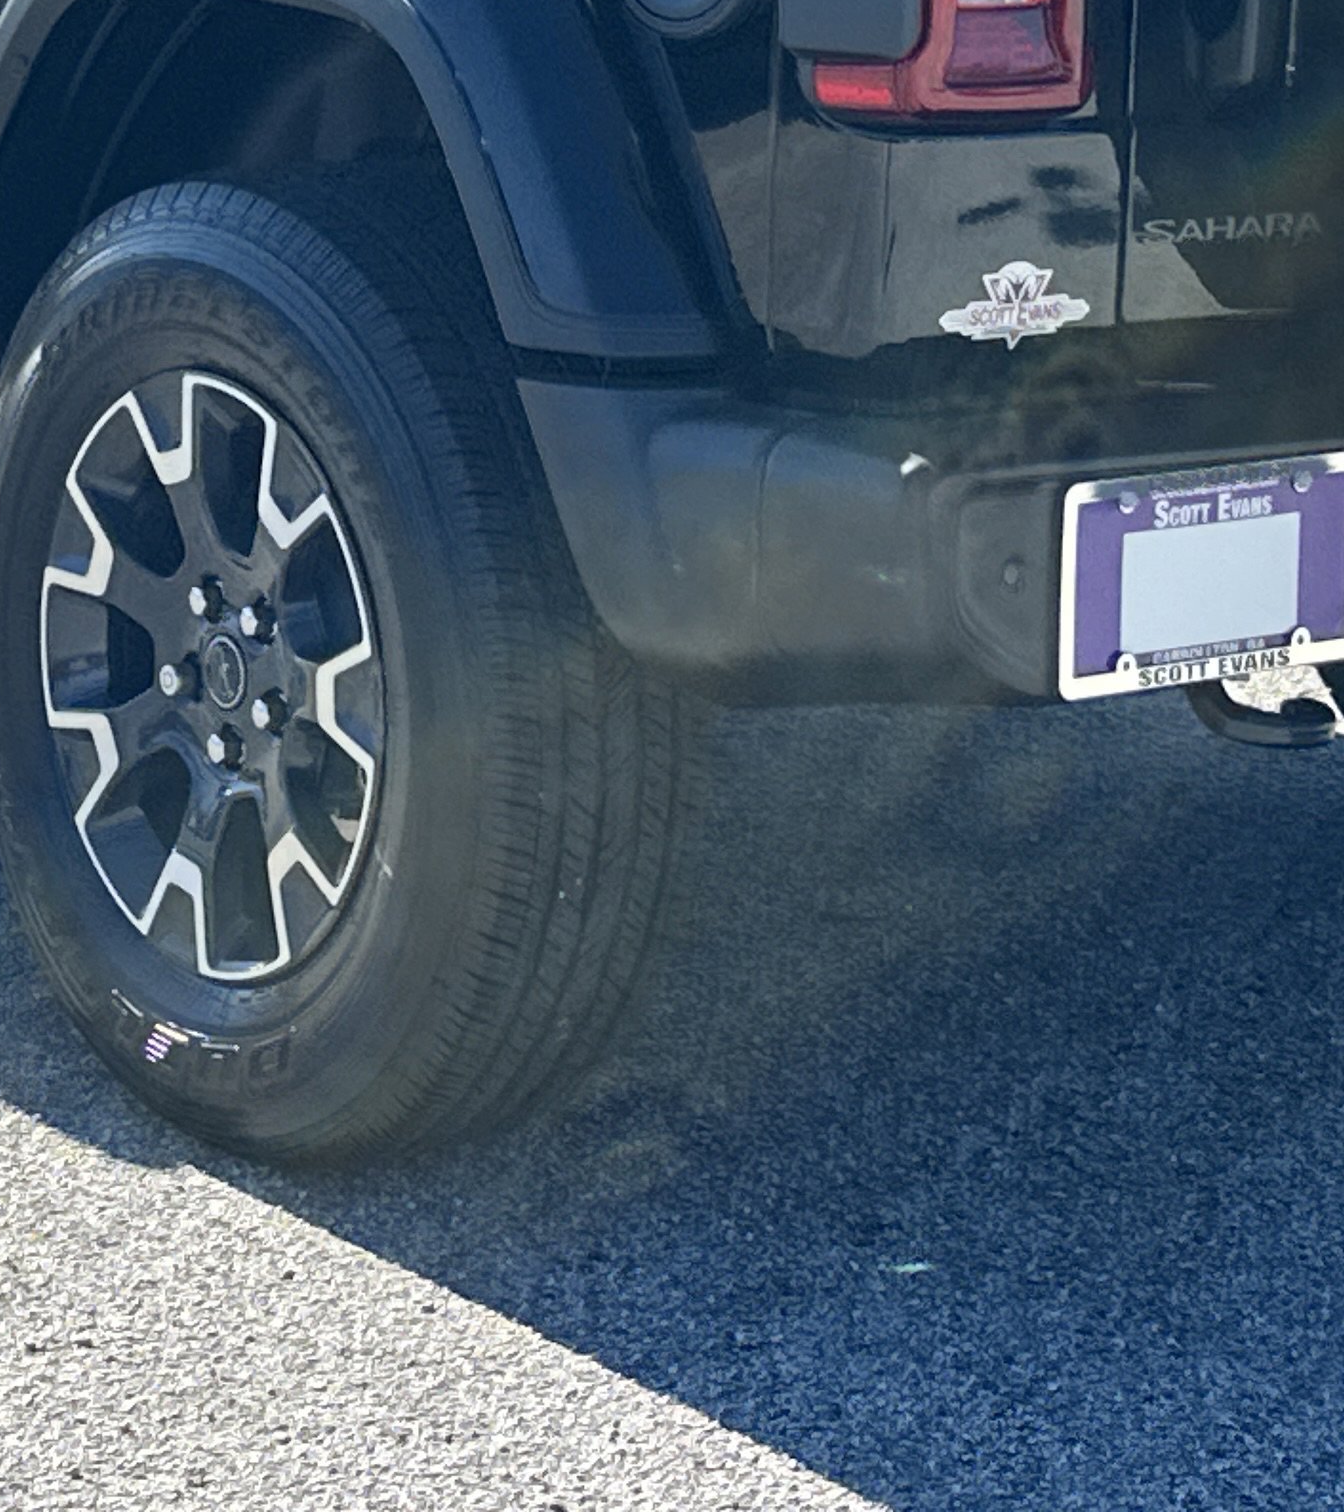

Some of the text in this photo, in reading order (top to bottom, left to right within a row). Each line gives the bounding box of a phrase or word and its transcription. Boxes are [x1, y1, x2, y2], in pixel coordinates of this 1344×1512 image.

[1143, 212, 1323, 246] SAHARA
[1154, 492, 1273, 529] SCOTT EVANS
[1138, 647, 1291, 687] SCOTT EVANS
